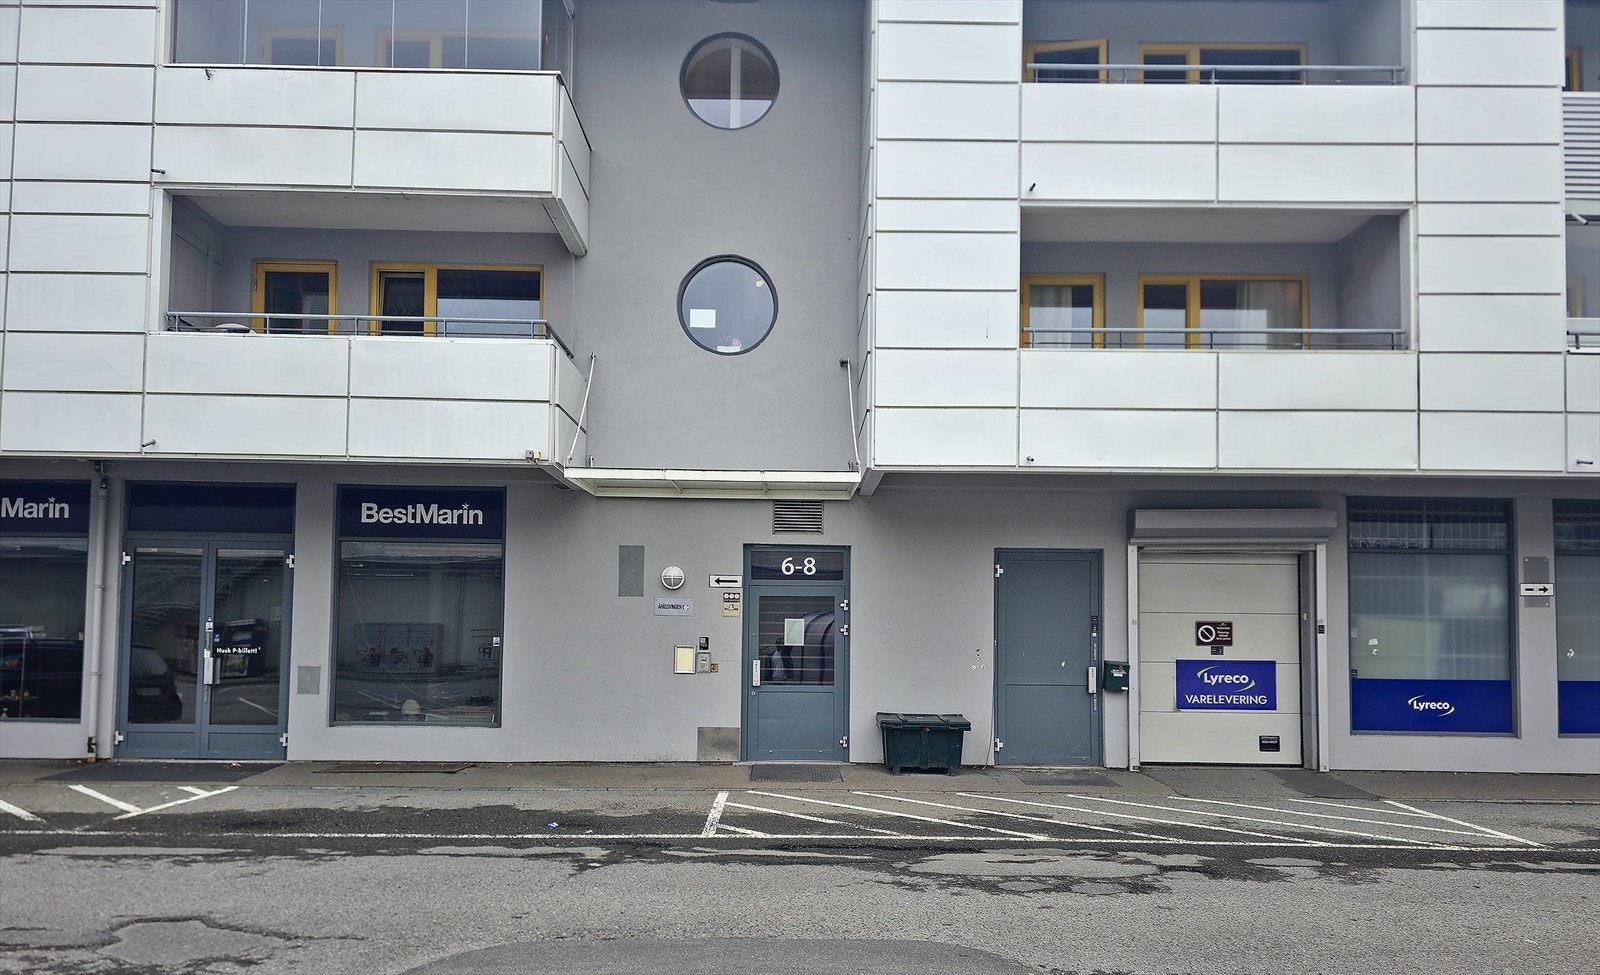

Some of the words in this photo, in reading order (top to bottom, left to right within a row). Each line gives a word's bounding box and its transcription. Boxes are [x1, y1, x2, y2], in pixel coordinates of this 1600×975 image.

[1, 497, 70, 519] Marin
[360, 502, 483, 525] BestMarin
[781, 557, 817, 576] 6-8
[1203, 672, 1249, 686] Lyreco
[1185, 694, 1268, 705] VARELEVERING
[1413, 700, 1450, 711] Lyreco
